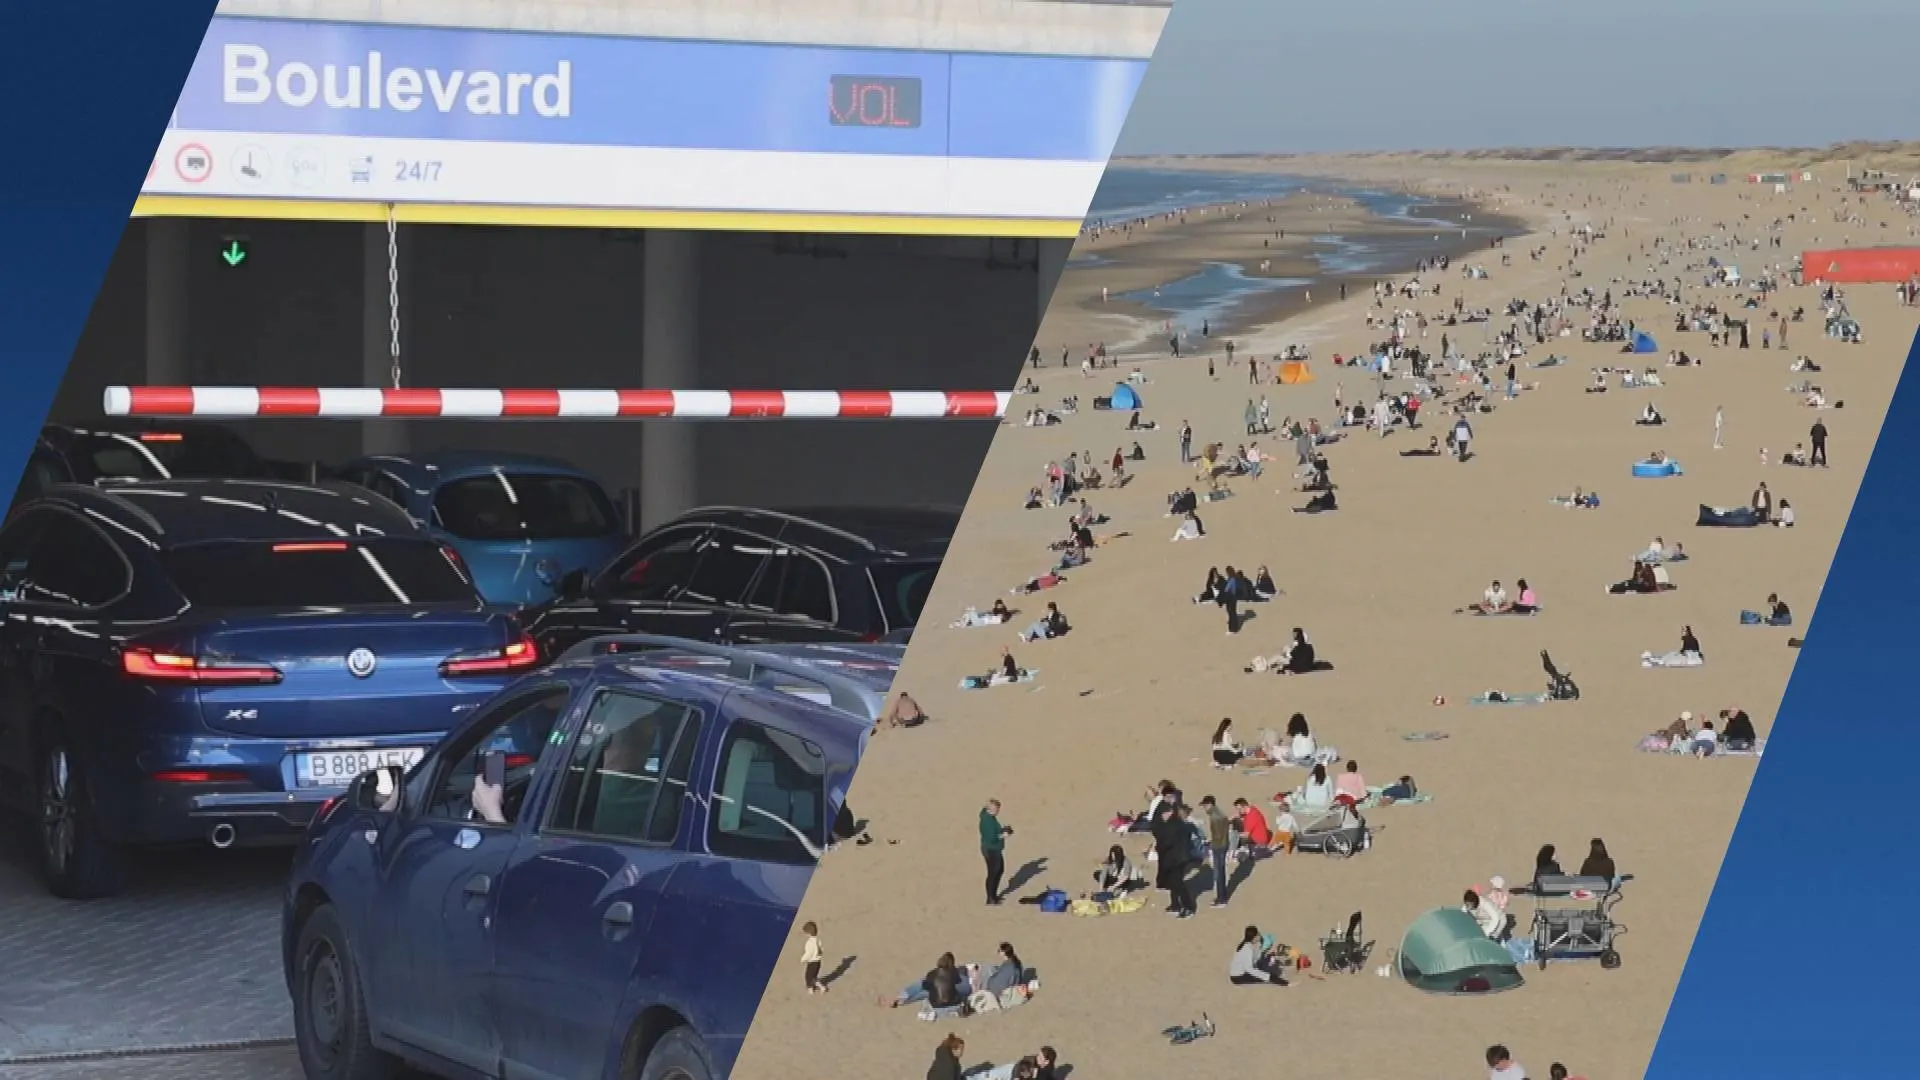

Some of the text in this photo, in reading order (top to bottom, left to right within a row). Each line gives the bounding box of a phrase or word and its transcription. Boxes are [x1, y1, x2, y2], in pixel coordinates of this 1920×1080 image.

[223, 43, 572, 117] Boulevard
[829, 82, 910, 125] VOL
[395, 160, 443, 181] 24/7
[312, 755, 327, 776] B
[332, 754, 369, 775] 888
